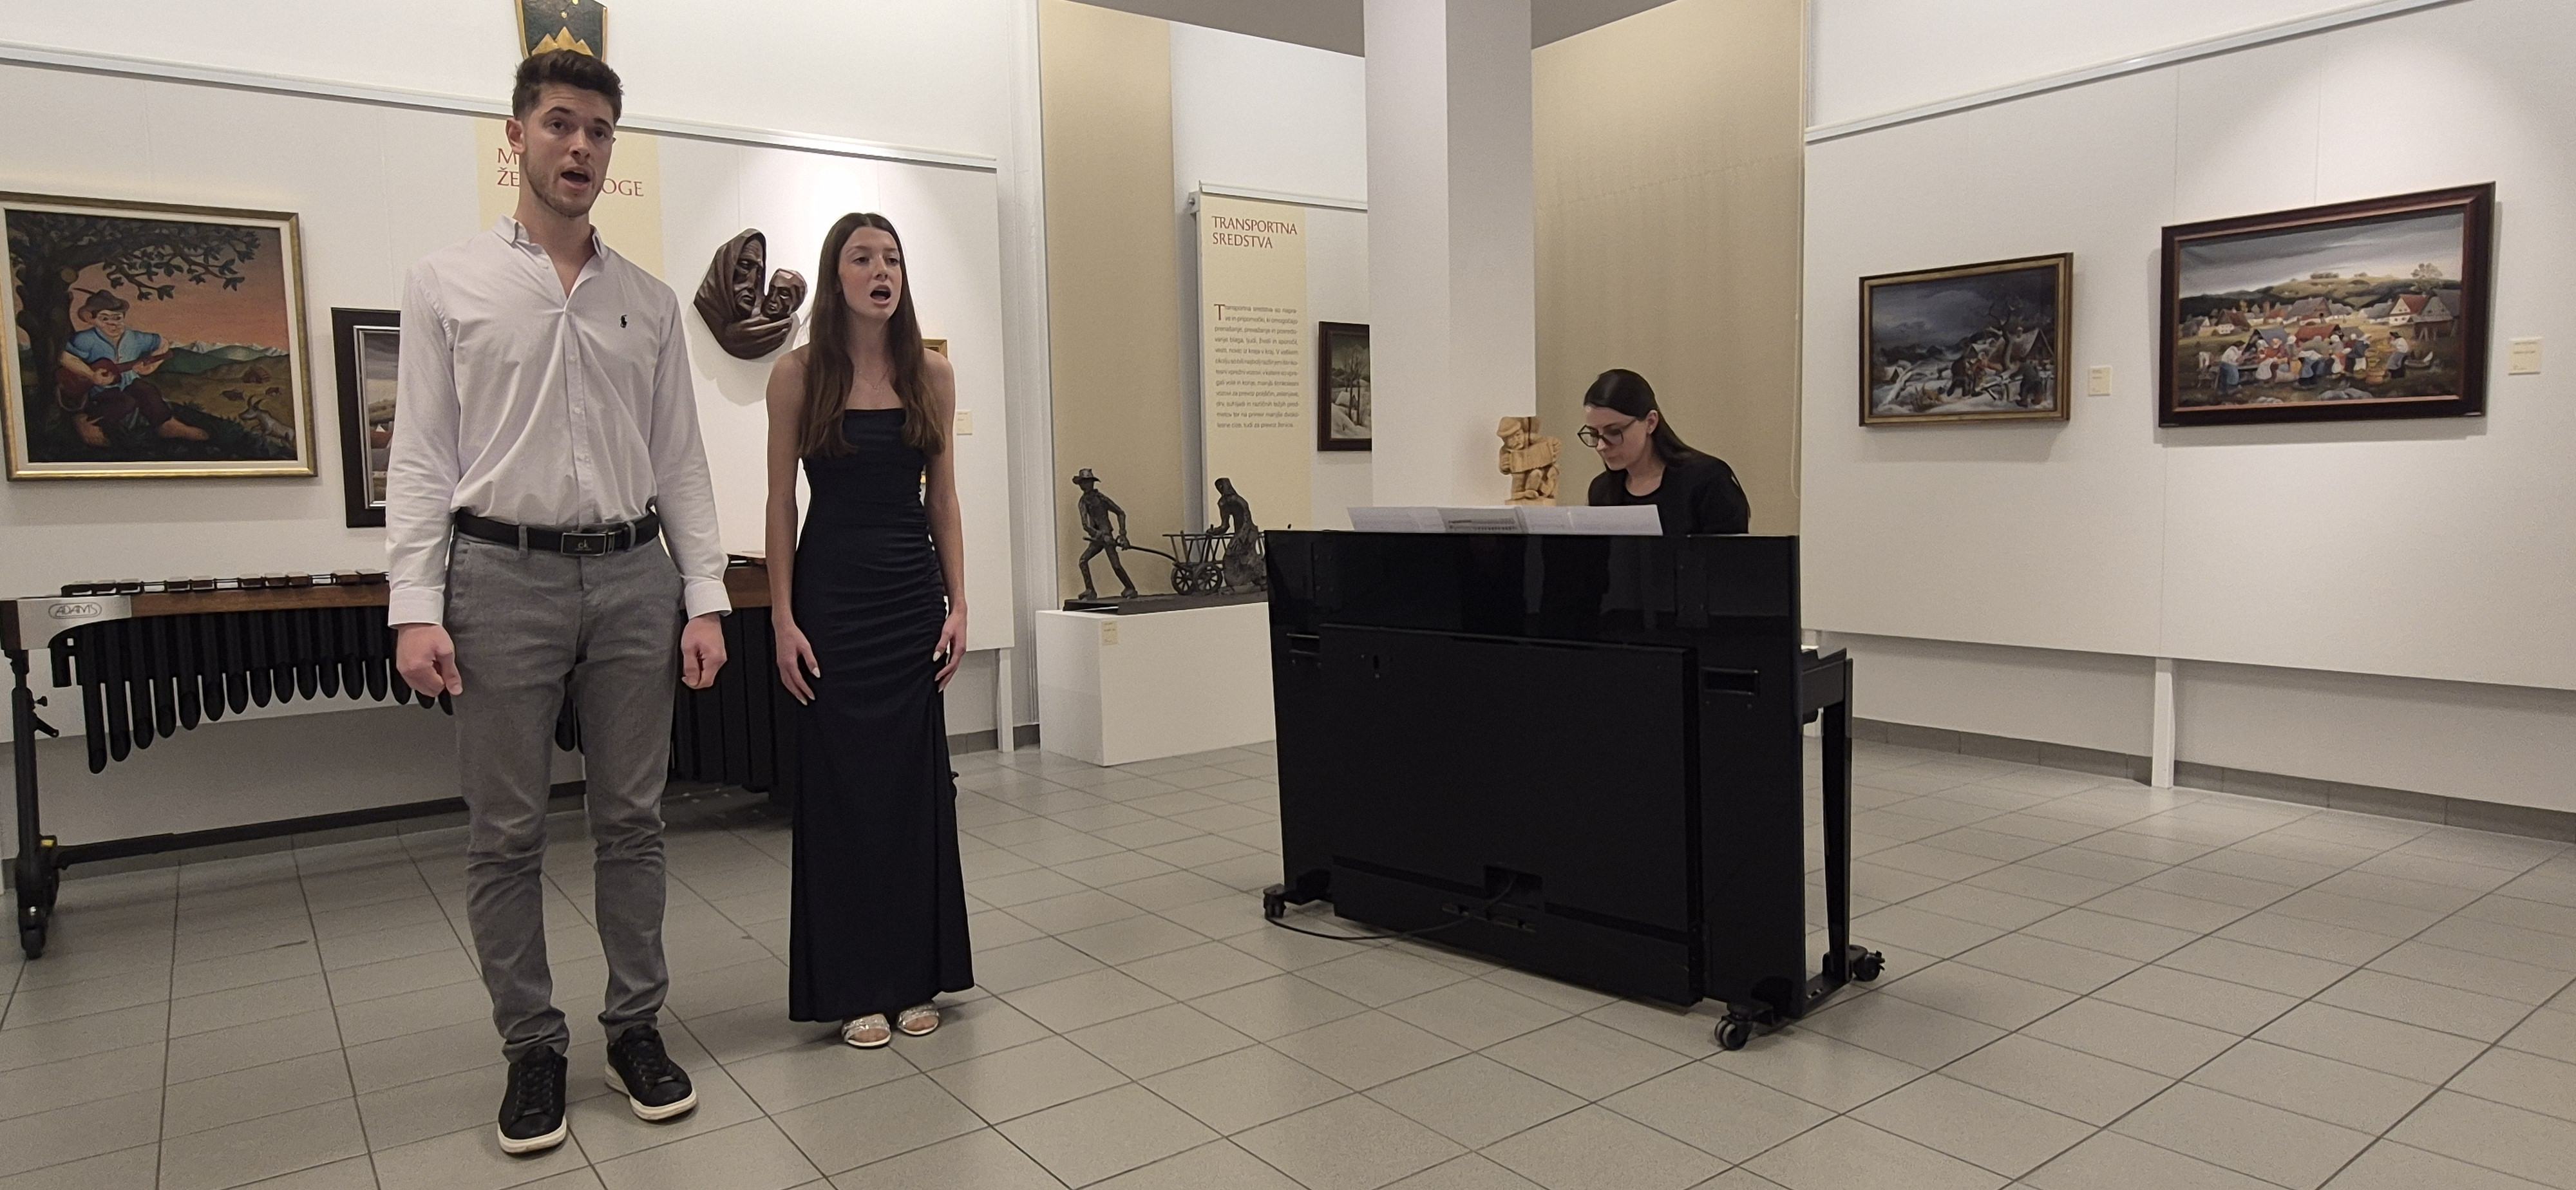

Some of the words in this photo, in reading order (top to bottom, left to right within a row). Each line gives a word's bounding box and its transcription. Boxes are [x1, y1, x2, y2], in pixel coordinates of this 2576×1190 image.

[497, 167, 520, 187] ŽE
[601, 178, 644, 196] OGE
[1211, 216, 1298, 235] TRANSPORTNA
[1213, 232, 1273, 249] SREDSTVA
[55, 604, 97, 617] ADAMS
